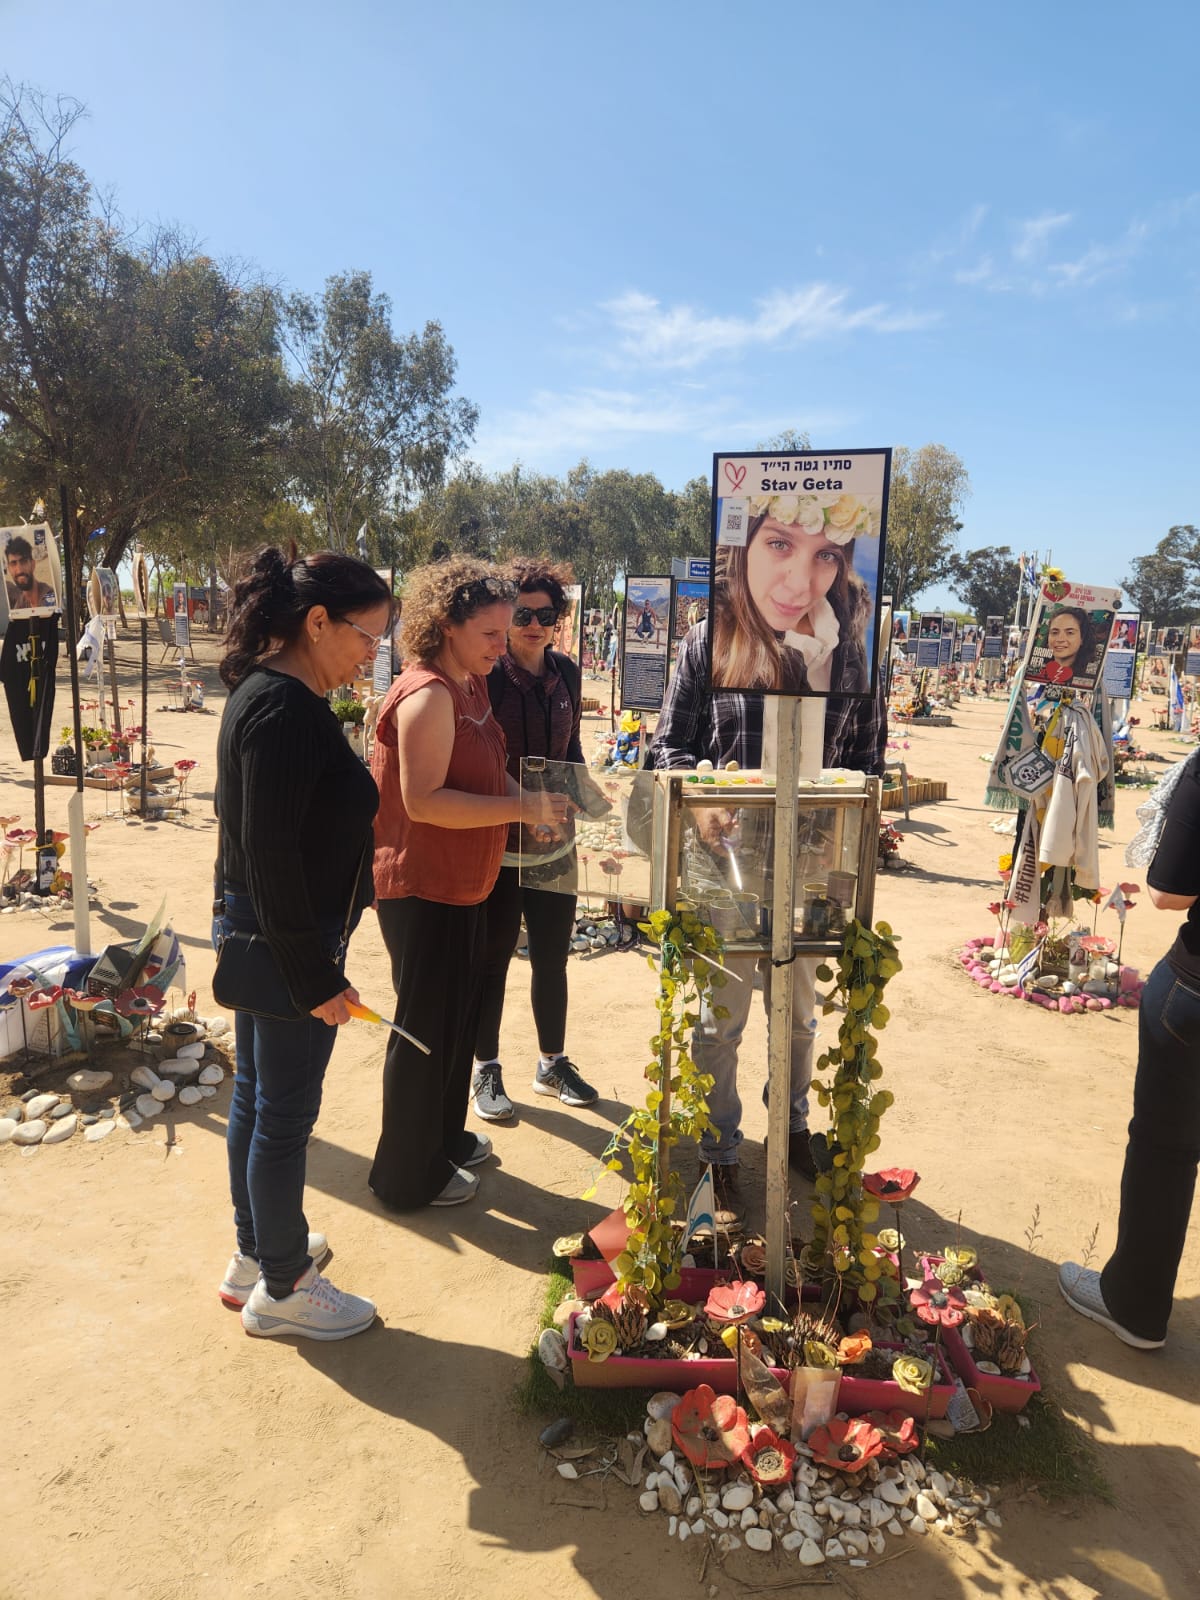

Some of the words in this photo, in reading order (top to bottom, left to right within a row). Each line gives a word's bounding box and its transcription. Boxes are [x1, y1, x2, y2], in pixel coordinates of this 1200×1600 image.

[794, 460, 818, 472] גטה
[823, 459, 852, 471] סתיו
[760, 478, 797, 492] Stav
[802, 477, 843, 491] Geta
